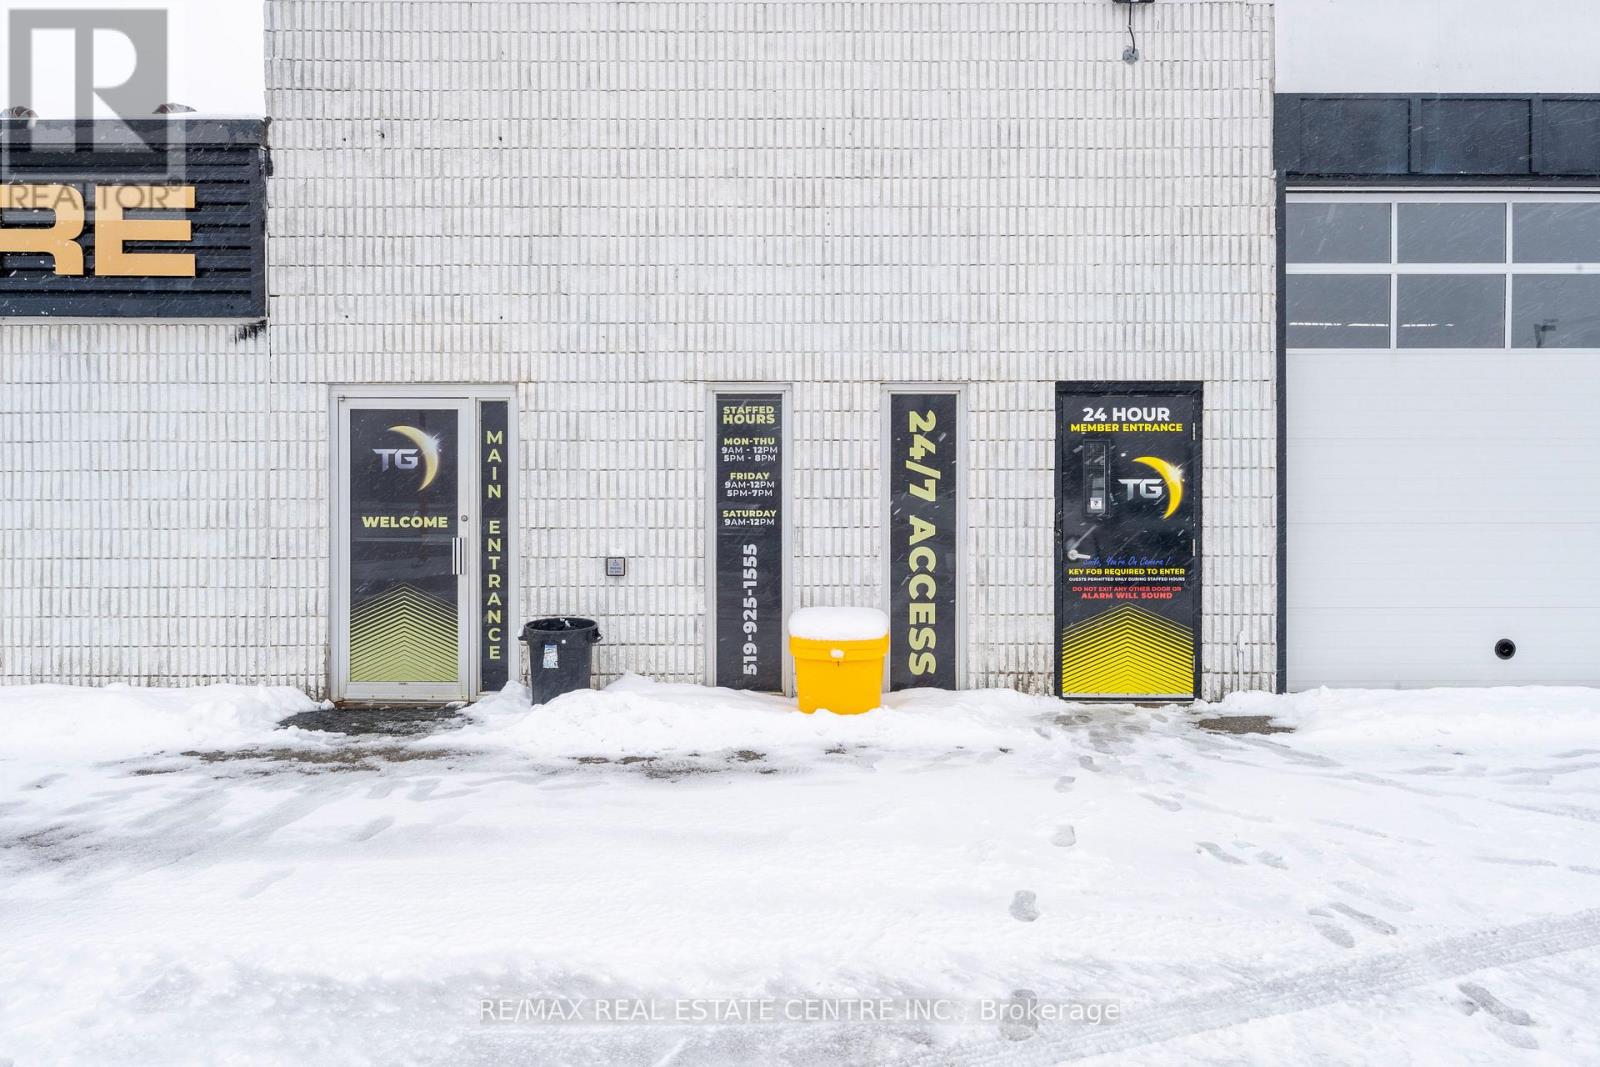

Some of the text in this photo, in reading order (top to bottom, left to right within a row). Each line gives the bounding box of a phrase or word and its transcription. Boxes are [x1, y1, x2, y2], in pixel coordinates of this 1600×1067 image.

[722, 406, 774, 414] STAFFED
[1082, 407, 1170, 422] 24 HOUR
[723, 414, 776, 424] HOURS
[1070, 424, 1183, 432] MEMBER ENTRANCE
[724, 438, 775, 446] MON-THU
[372, 448, 418, 472] TG
[730, 472, 770, 480] FRIDAY
[1118, 478, 1162, 501] TG
[722, 510, 776, 518] SATURDAY
[362, 516, 448, 528] WELCOME
[486, 430, 502, 660] MAIN ENTRANCE
[906, 410, 940, 676] 24/7 ACCESS
[743, 544, 758, 676] 519-925-1555
